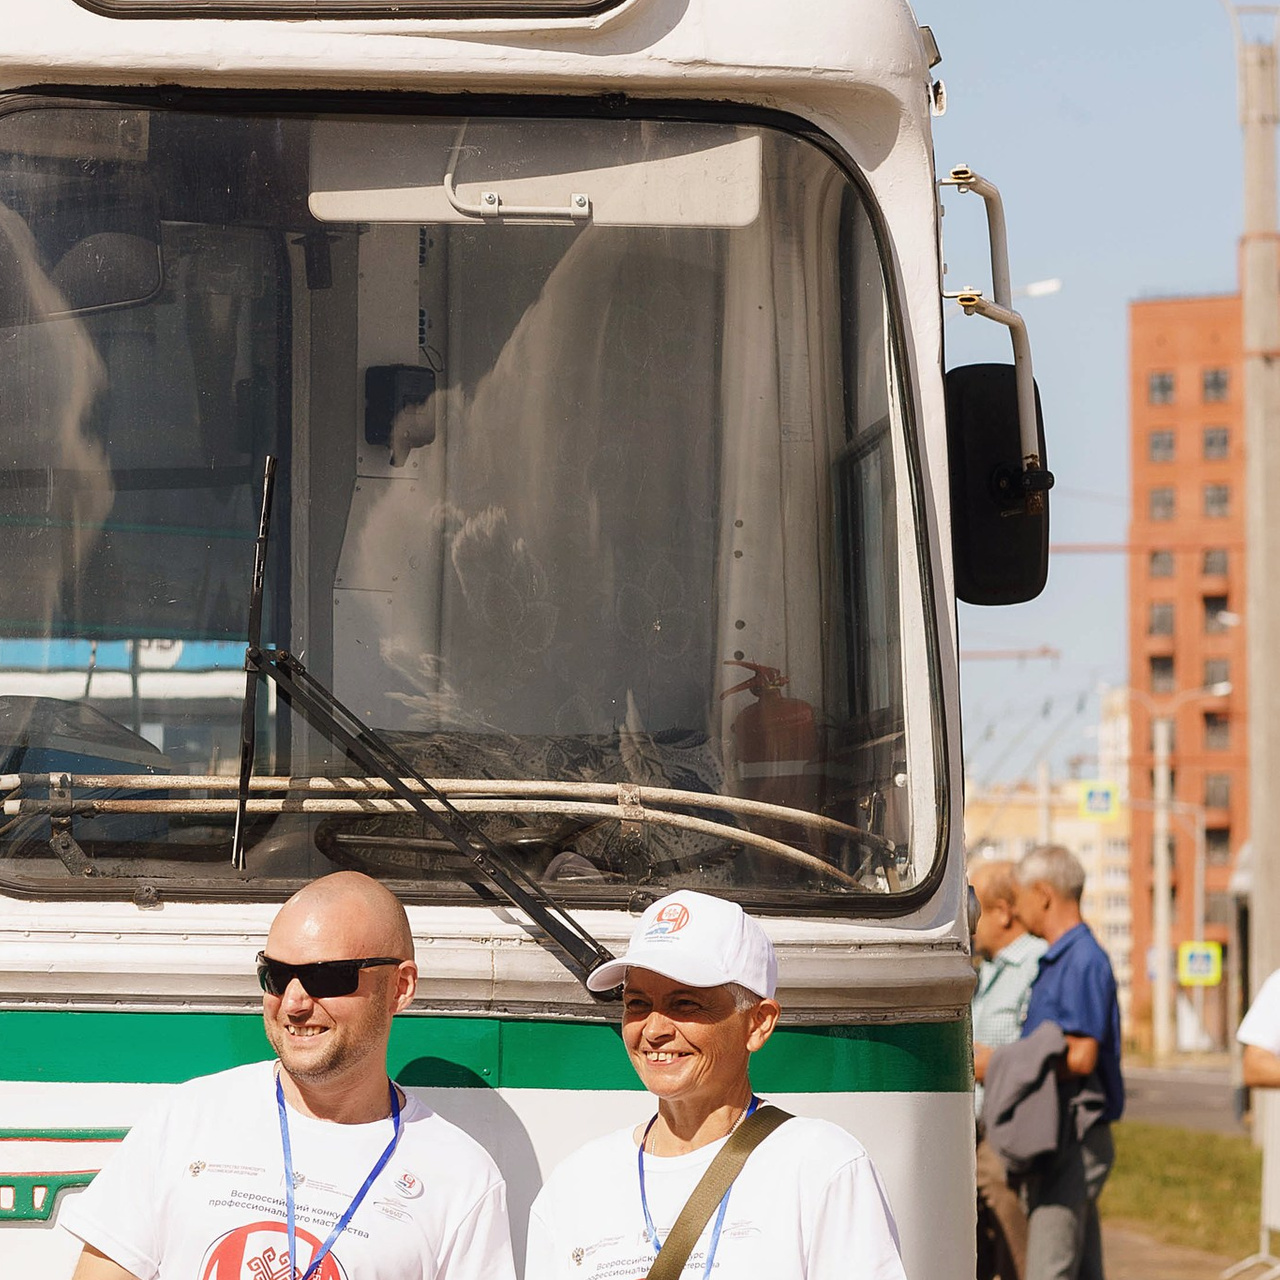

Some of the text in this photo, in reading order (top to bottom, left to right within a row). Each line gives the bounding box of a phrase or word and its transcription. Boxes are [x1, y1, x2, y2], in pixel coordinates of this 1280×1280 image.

[208, 1199, 370, 1239] профессиональого мастрства
[230, 1189, 353, 1224] Всероссийкий конку
